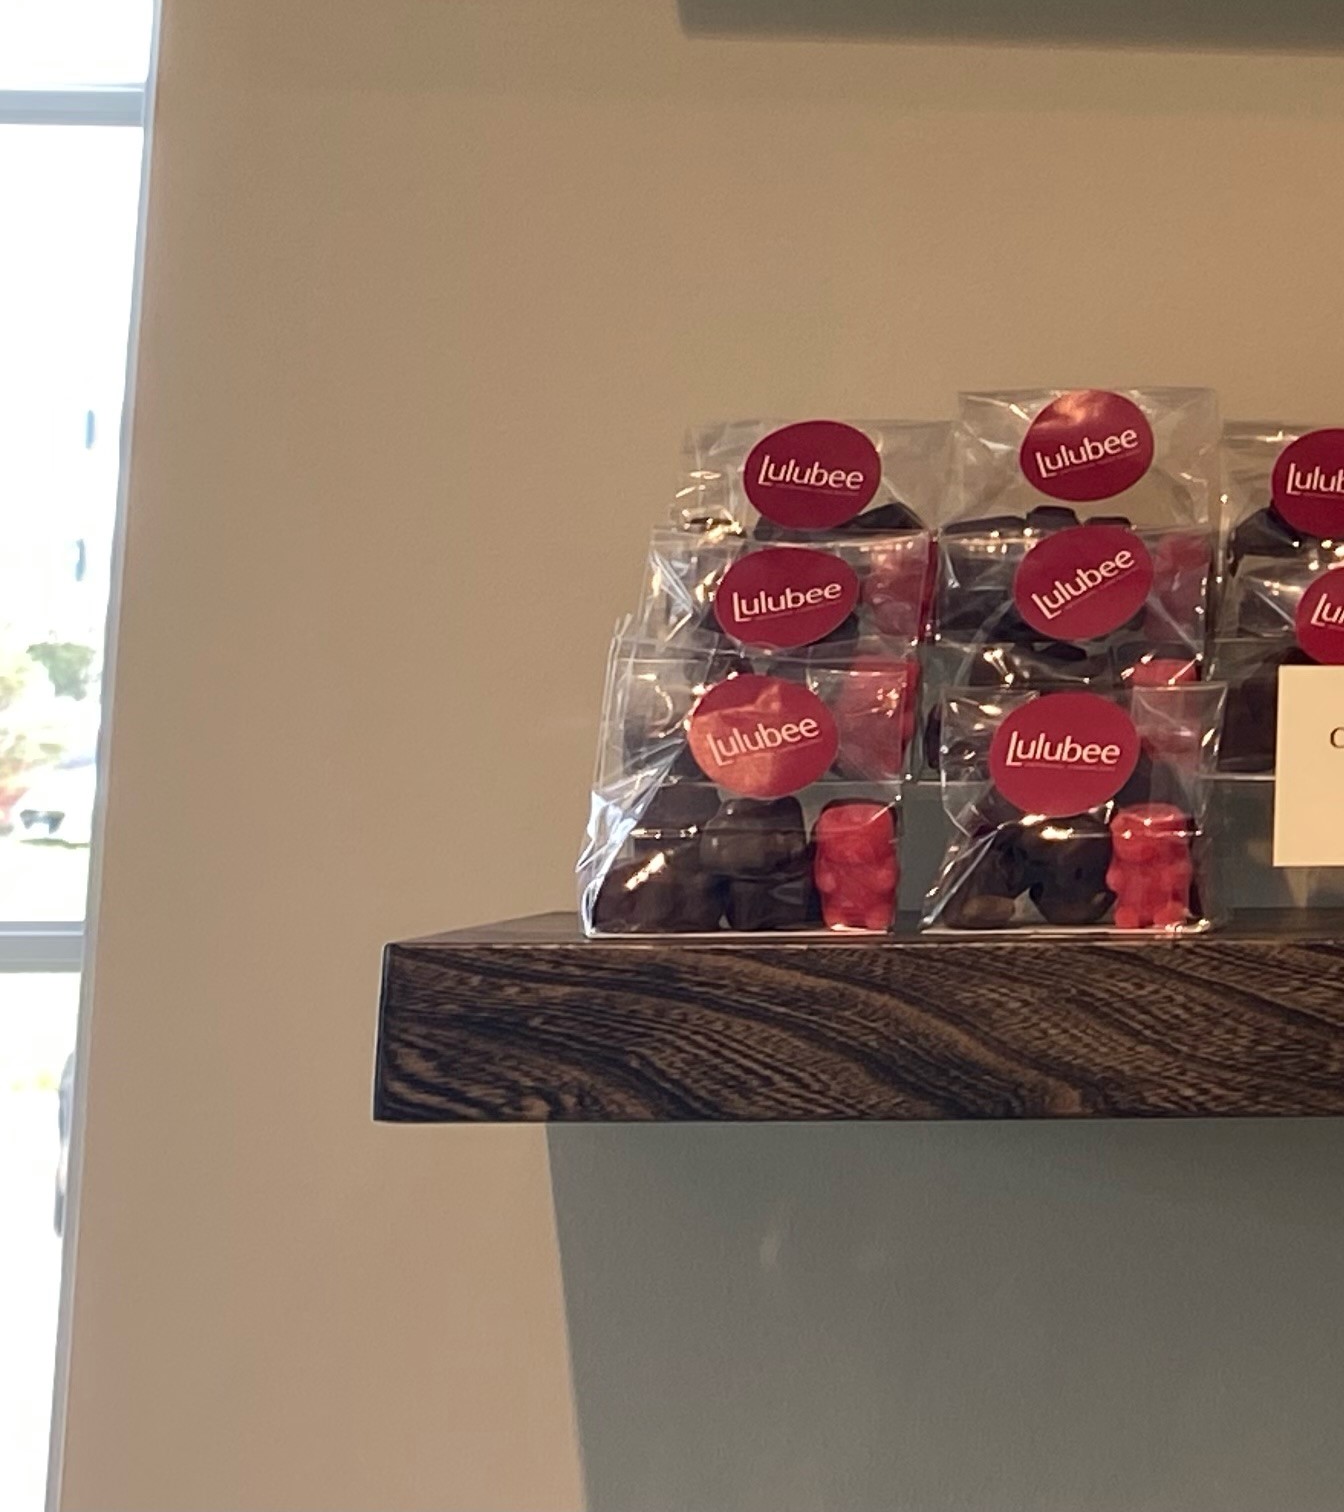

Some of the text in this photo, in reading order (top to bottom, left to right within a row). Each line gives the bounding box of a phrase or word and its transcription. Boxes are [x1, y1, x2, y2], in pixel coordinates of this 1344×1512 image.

[758, 455, 864, 489] Lulubee
[1035, 429, 1138, 478] Lulubee
[732, 583, 842, 622] Lulubee
[1031, 550, 1135, 619] Lulubee
[706, 718, 819, 766] Lulubee
[1005, 731, 1121, 766] Lulubee
